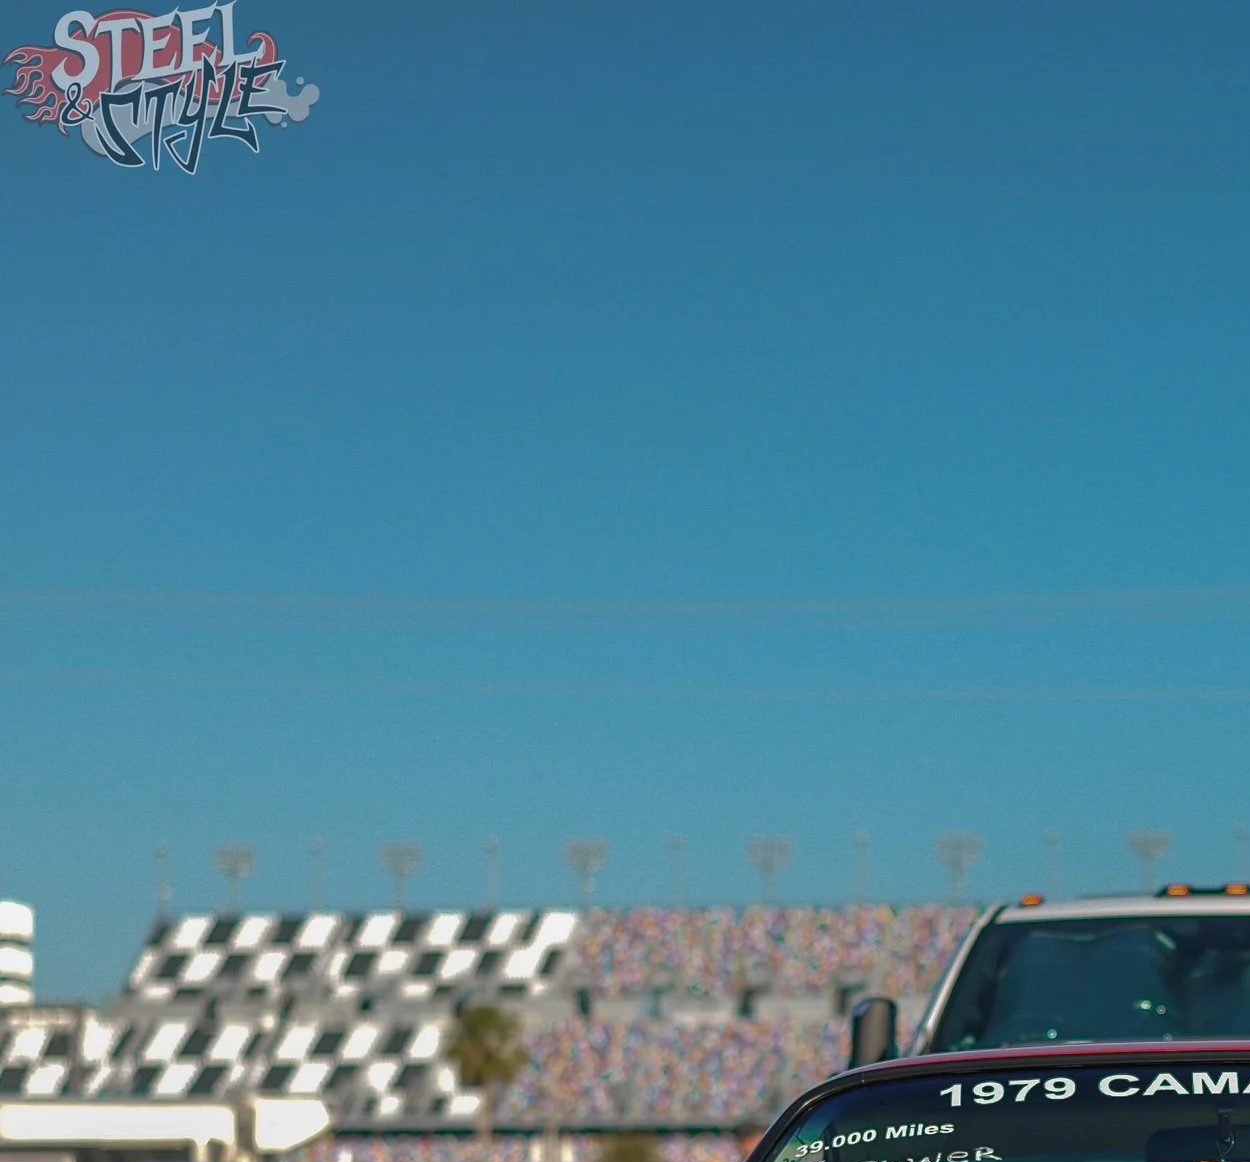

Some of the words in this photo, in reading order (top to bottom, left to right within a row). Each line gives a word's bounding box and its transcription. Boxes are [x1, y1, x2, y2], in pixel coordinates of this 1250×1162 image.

[939, 1076, 1077, 1108] 1979
[794, 1129, 877, 1158] 39.000
[885, 1123, 955, 1140] Miles
